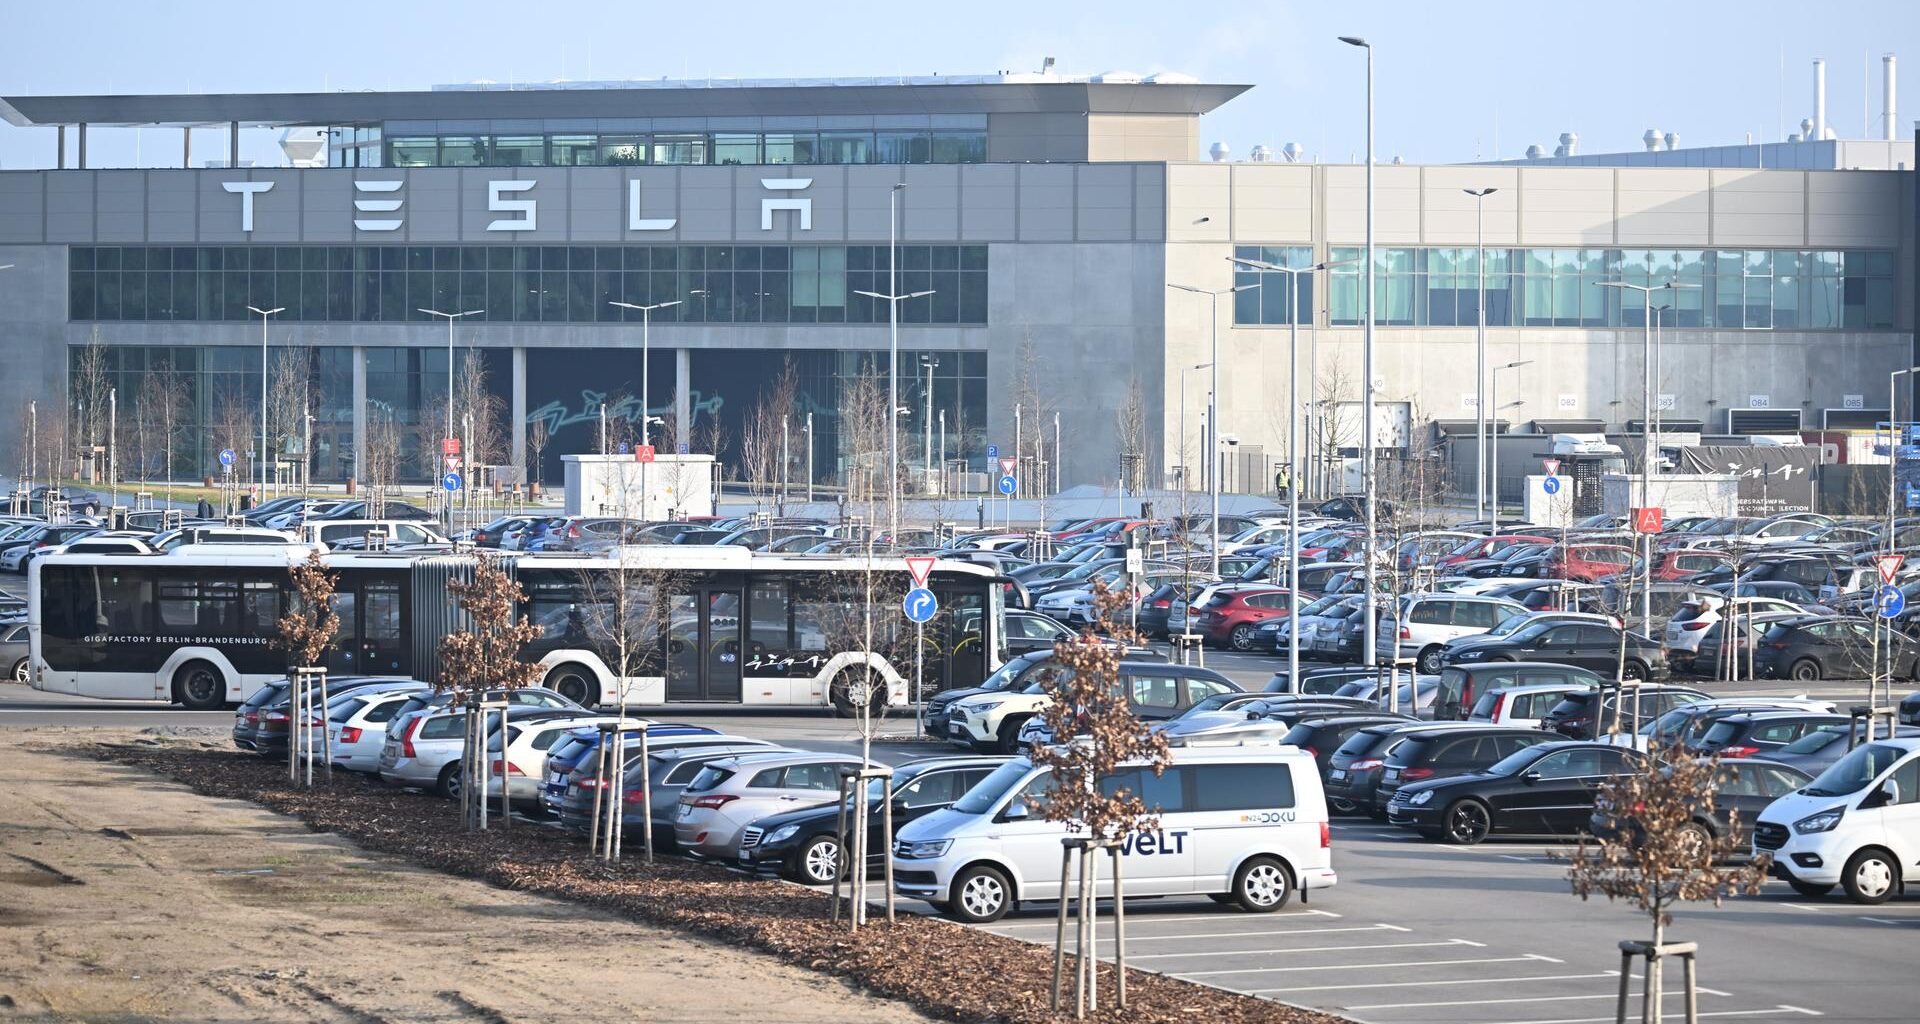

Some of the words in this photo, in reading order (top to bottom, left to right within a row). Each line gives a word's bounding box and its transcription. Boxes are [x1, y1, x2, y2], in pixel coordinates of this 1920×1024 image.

[221, 179, 814, 232] TESLA
[1560, 398, 1576, 406] 082
[1751, 399, 1767, 407] 084
[1845, 399, 1861, 408] 085
[448, 442, 454, 450] E
[641, 448, 651, 458] A
[1644, 511, 1657, 527] A
[84, 635, 151, 643] GIGAFACTORY
[155, 636, 268, 645] BERLIN-BRANDENBURG
